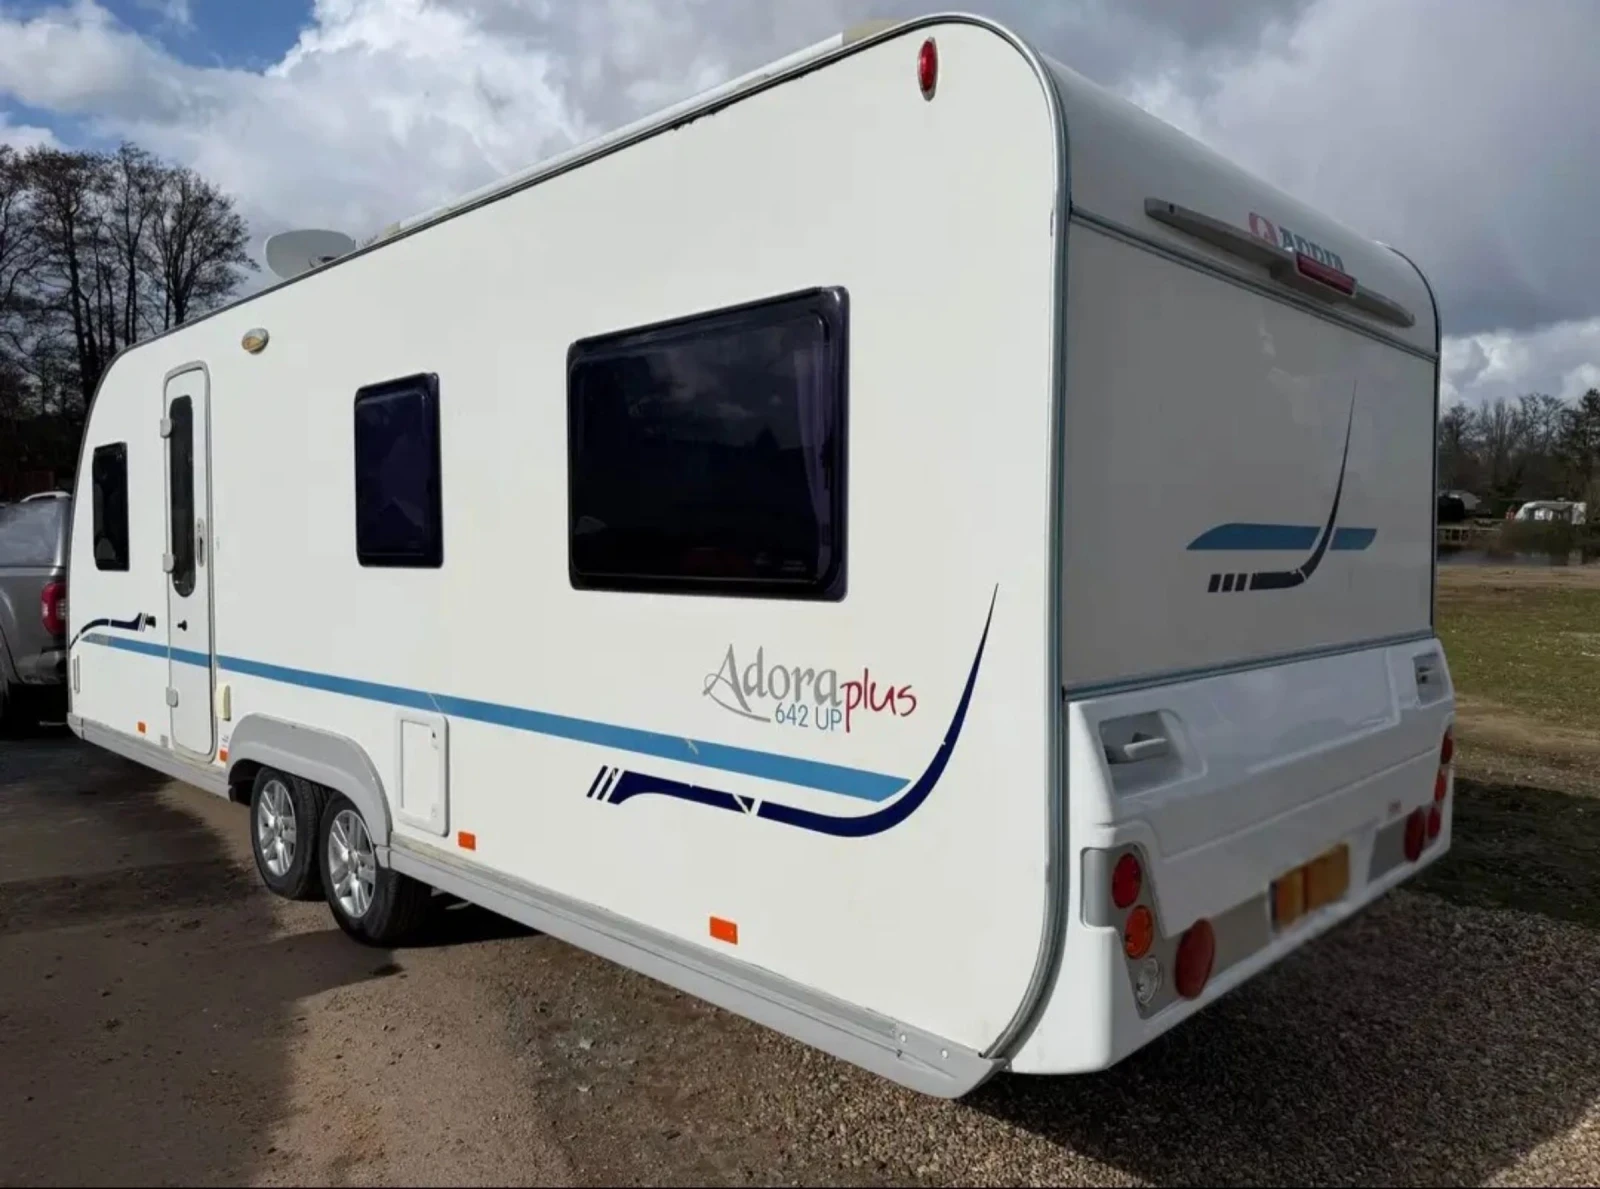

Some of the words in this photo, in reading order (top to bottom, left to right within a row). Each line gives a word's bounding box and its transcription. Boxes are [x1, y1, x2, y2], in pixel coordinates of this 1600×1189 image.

[703, 643, 842, 723] Adora
[840, 667, 917, 733] plus
[774, 702, 809, 728] 642
[815, 708, 842, 731] UP
